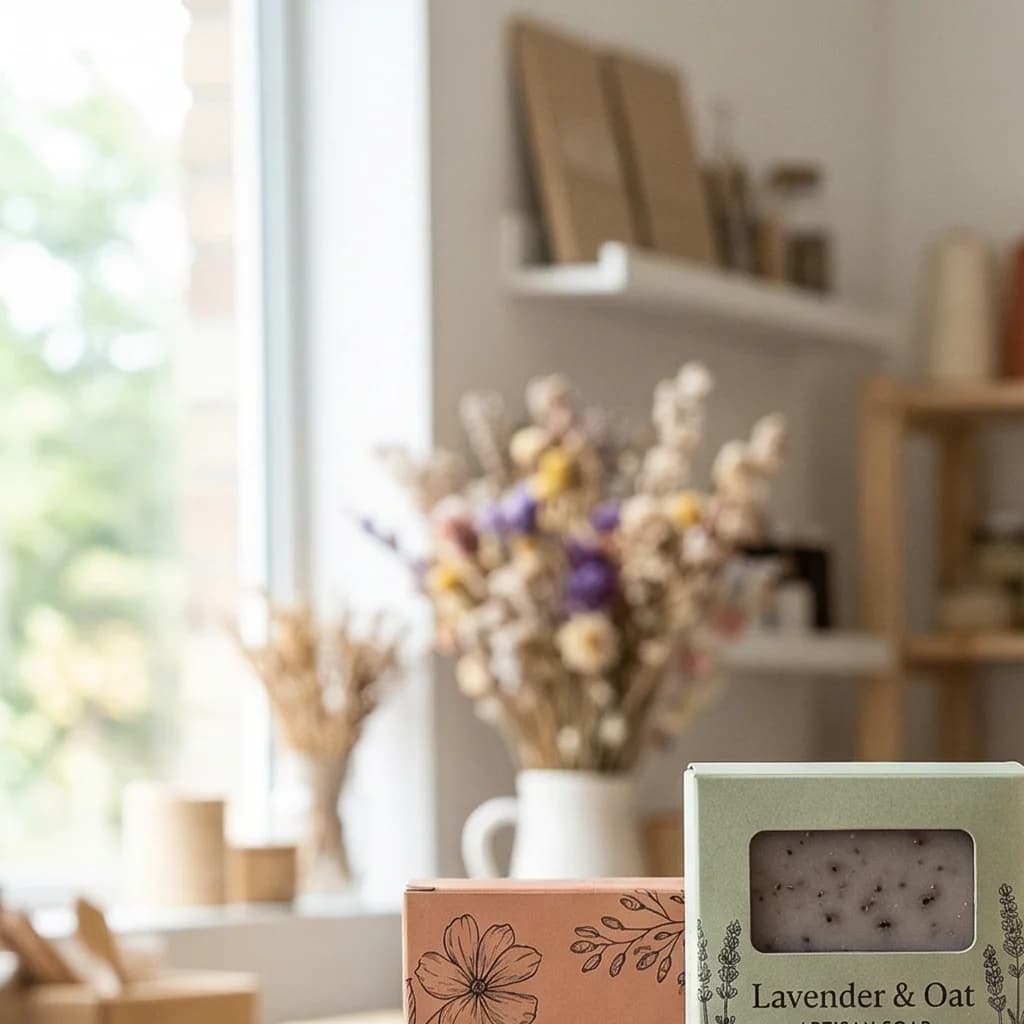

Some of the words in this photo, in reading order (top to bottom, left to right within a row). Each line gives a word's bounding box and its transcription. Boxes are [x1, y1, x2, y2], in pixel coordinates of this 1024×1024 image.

[752, 982, 886, 1008] Lavender
[893, 982, 915, 1007] &
[925, 982, 975, 1007] Oat
